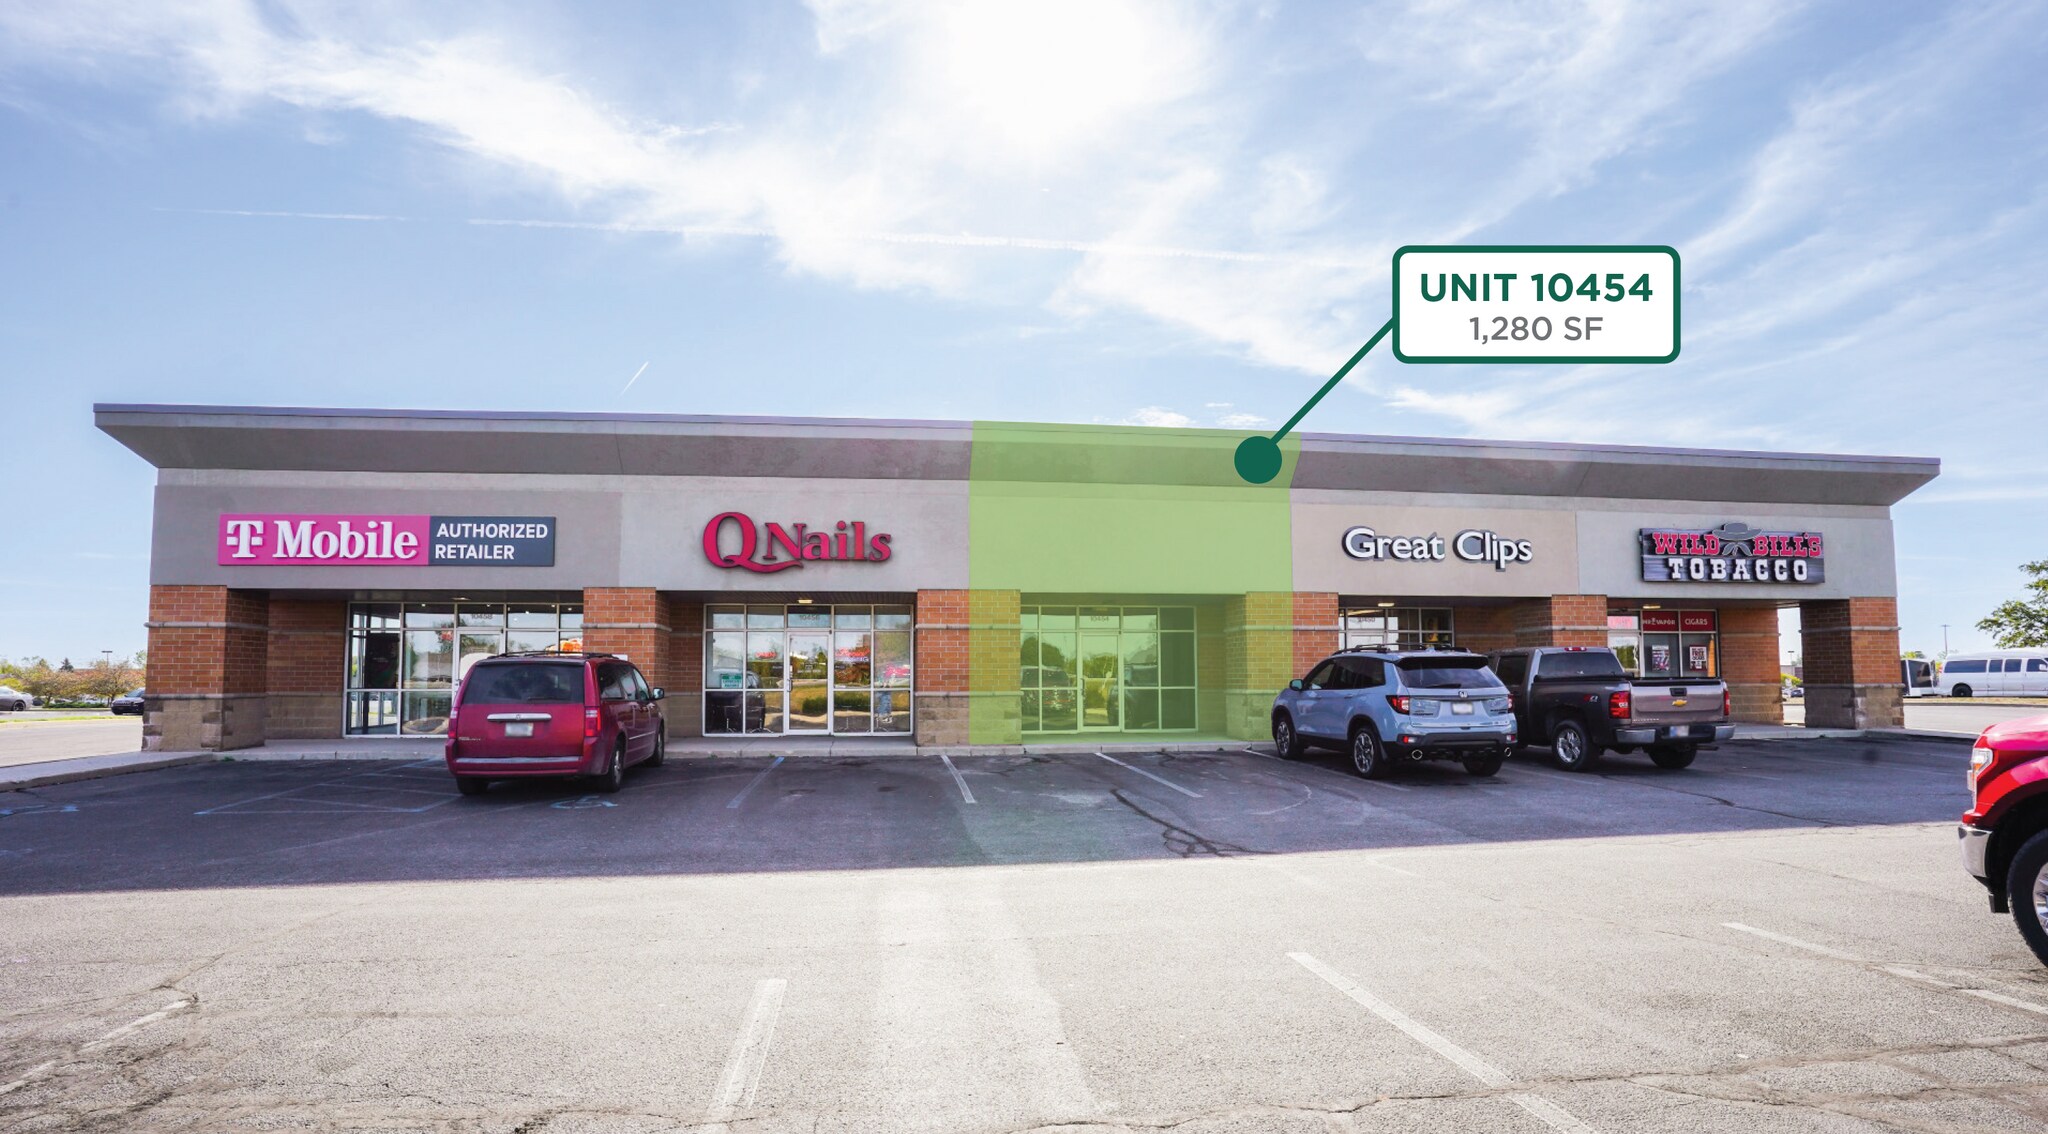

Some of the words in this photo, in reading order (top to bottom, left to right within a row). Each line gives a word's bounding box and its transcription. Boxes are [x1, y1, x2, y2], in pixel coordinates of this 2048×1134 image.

[272, 519, 419, 559] Mobile
[436, 523, 548, 540] AUTHORIZED
[702, 511, 804, 574] Q
[762, 520, 892, 563] Nails
[1652, 531, 1721, 556] WILD
[1752, 532, 1822, 558] BILL'S
[435, 544, 515, 560] RETAILER
[1342, 525, 1446, 562] Great
[1452, 528, 1533, 572] Clips
[1667, 557, 1809, 582] TOBACCO
[1684, 617, 1708, 626] CIGARS
